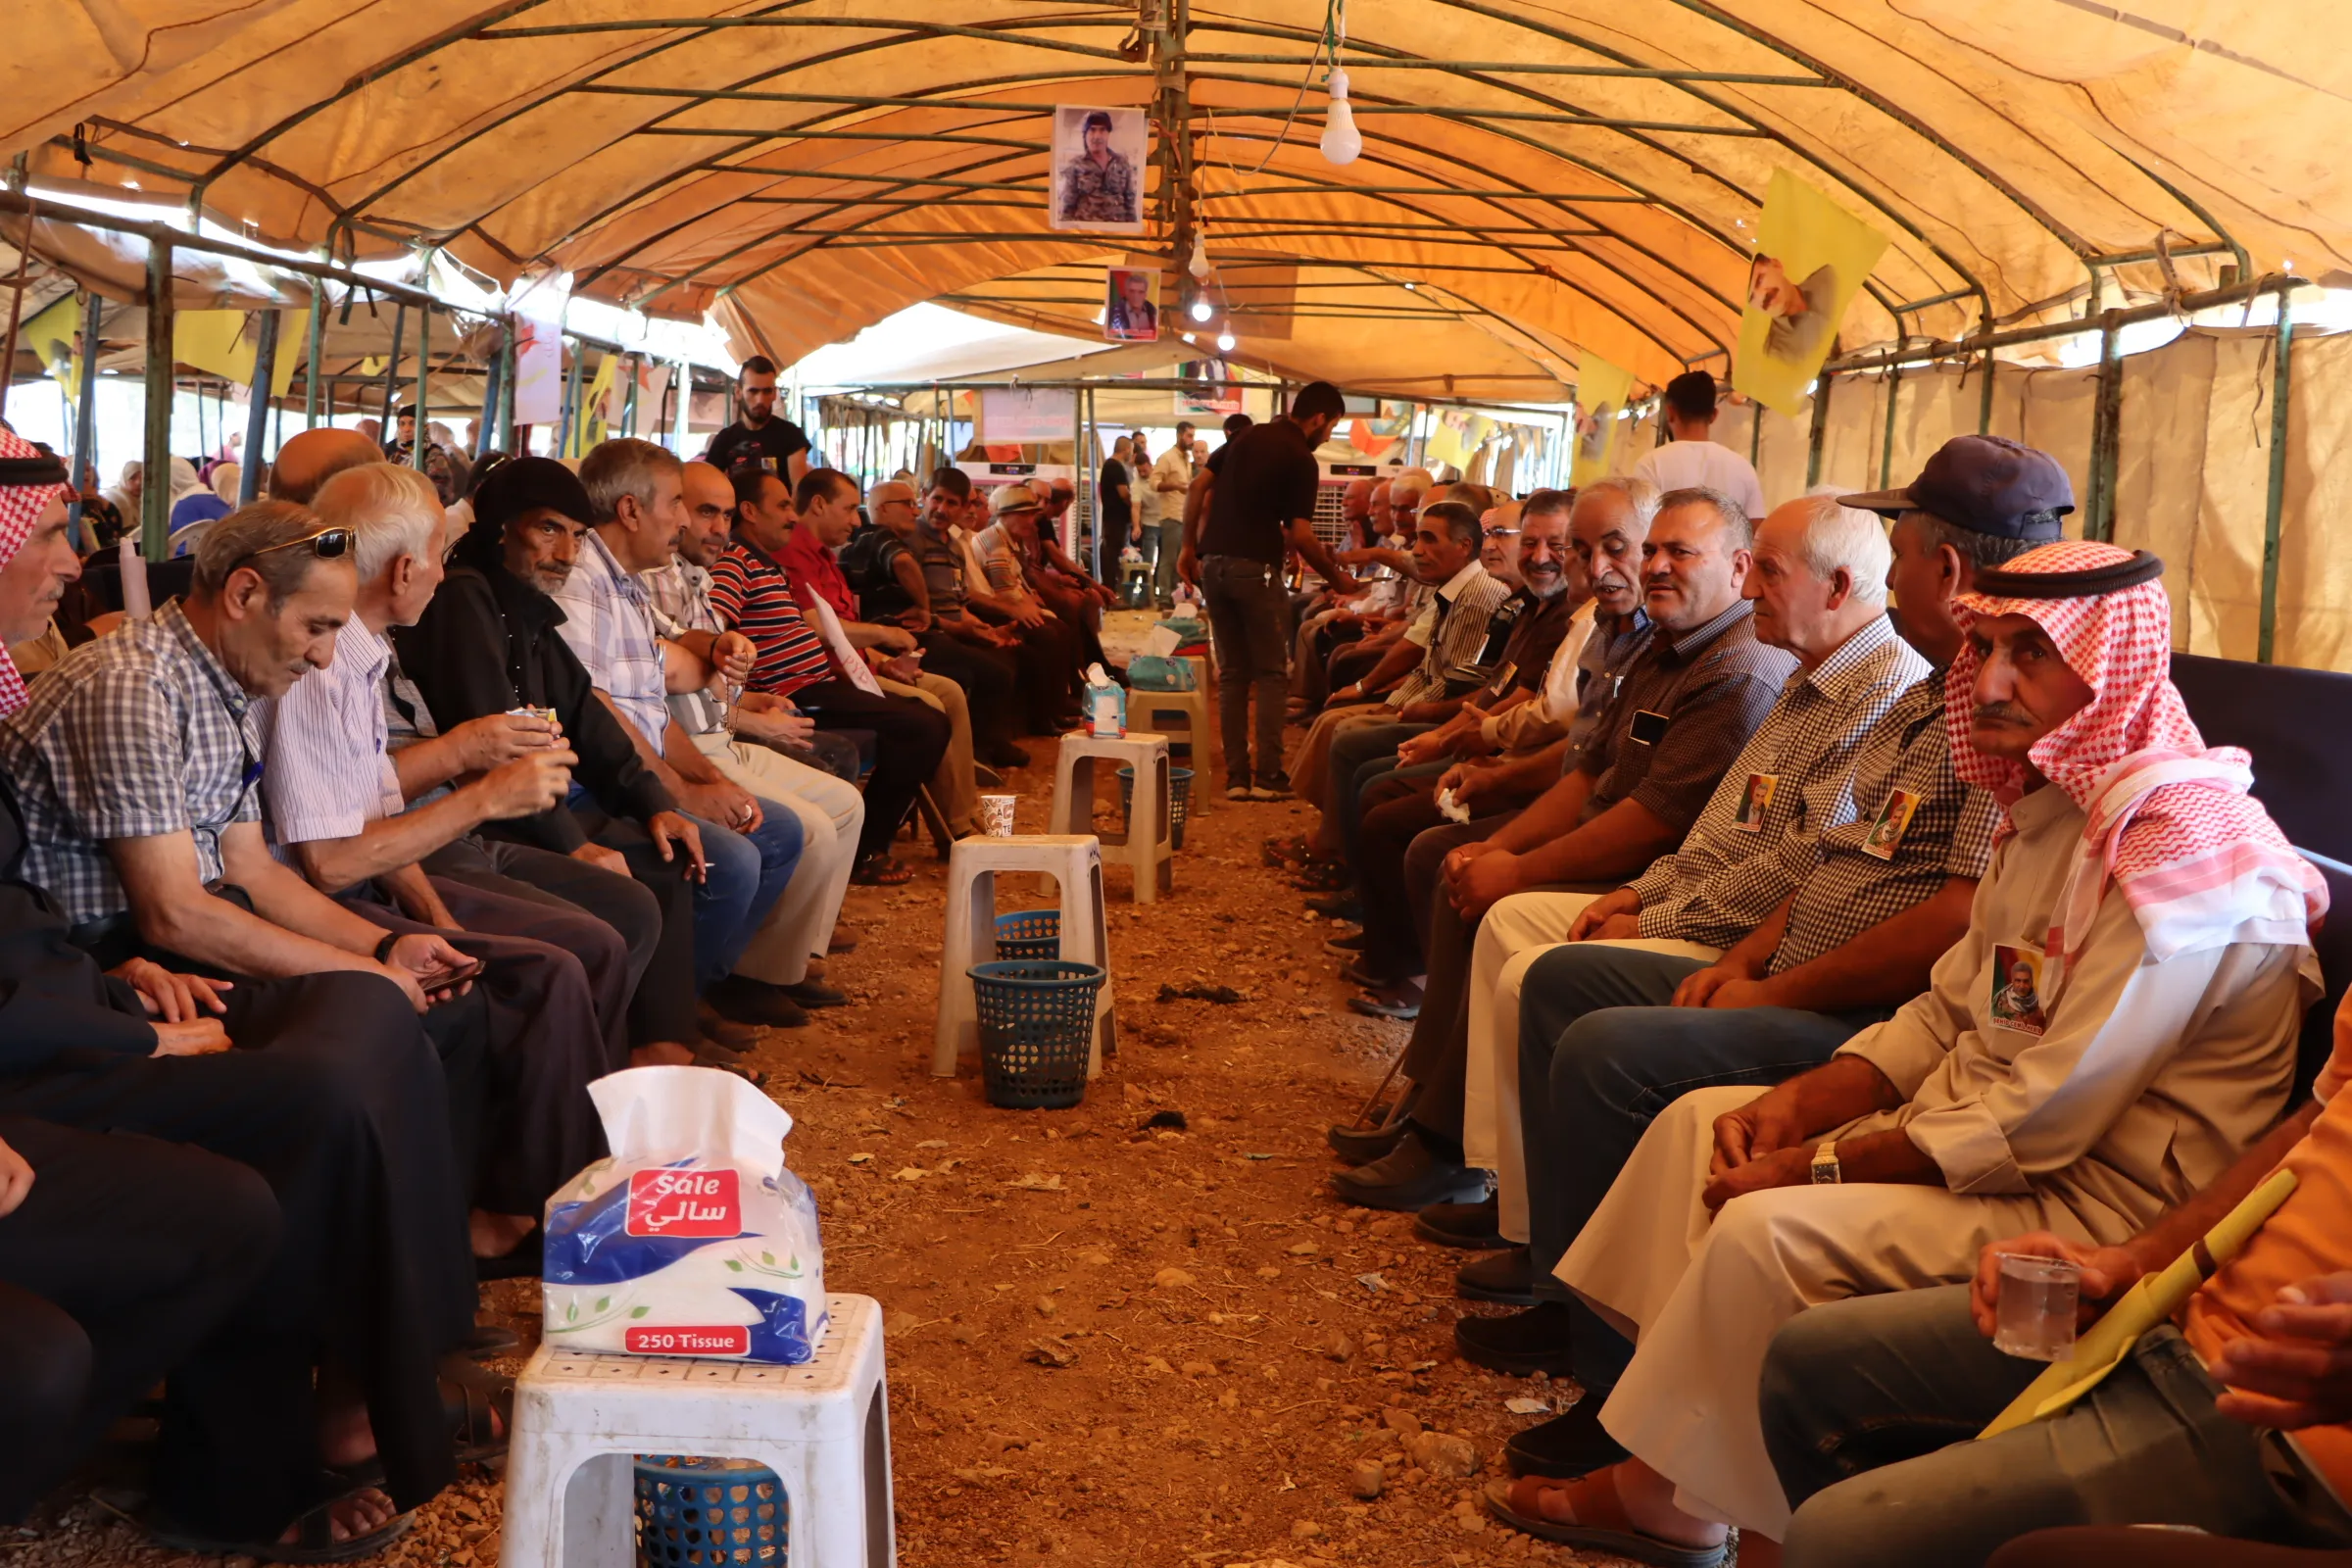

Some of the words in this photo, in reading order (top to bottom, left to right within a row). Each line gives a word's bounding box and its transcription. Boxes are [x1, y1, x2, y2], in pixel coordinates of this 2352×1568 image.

[656, 1175, 720, 1195] Sale
[645, 1201, 727, 1233] سالي
[638, 1334, 674, 1348] 250
[678, 1334, 735, 1348] Tissue
